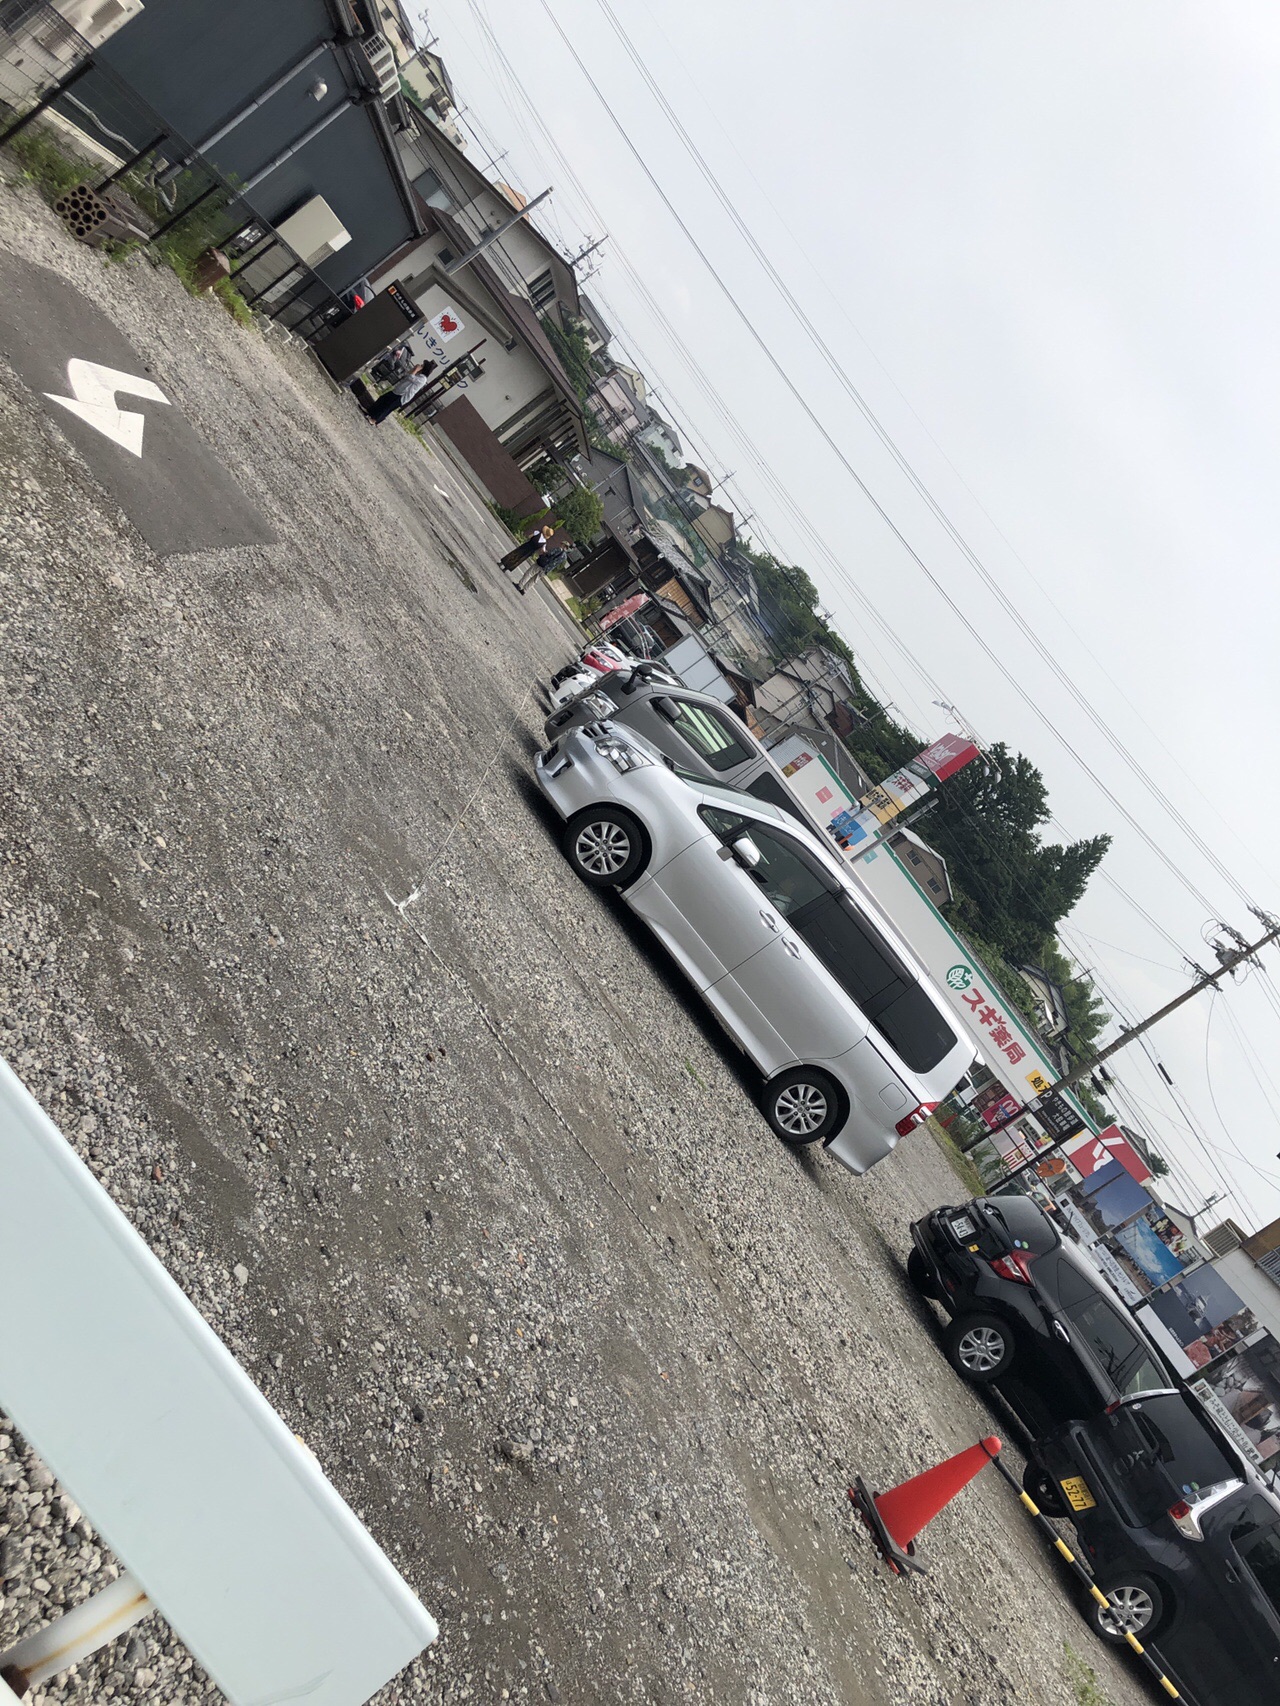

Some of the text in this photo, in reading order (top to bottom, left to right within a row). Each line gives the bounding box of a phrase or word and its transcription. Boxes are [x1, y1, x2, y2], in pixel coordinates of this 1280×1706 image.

[961, 987, 1026, 1065] スギ薬局
[1040, 1089, 1053, 1098] P
[1065, 1484, 1086, 1506] 52-77
